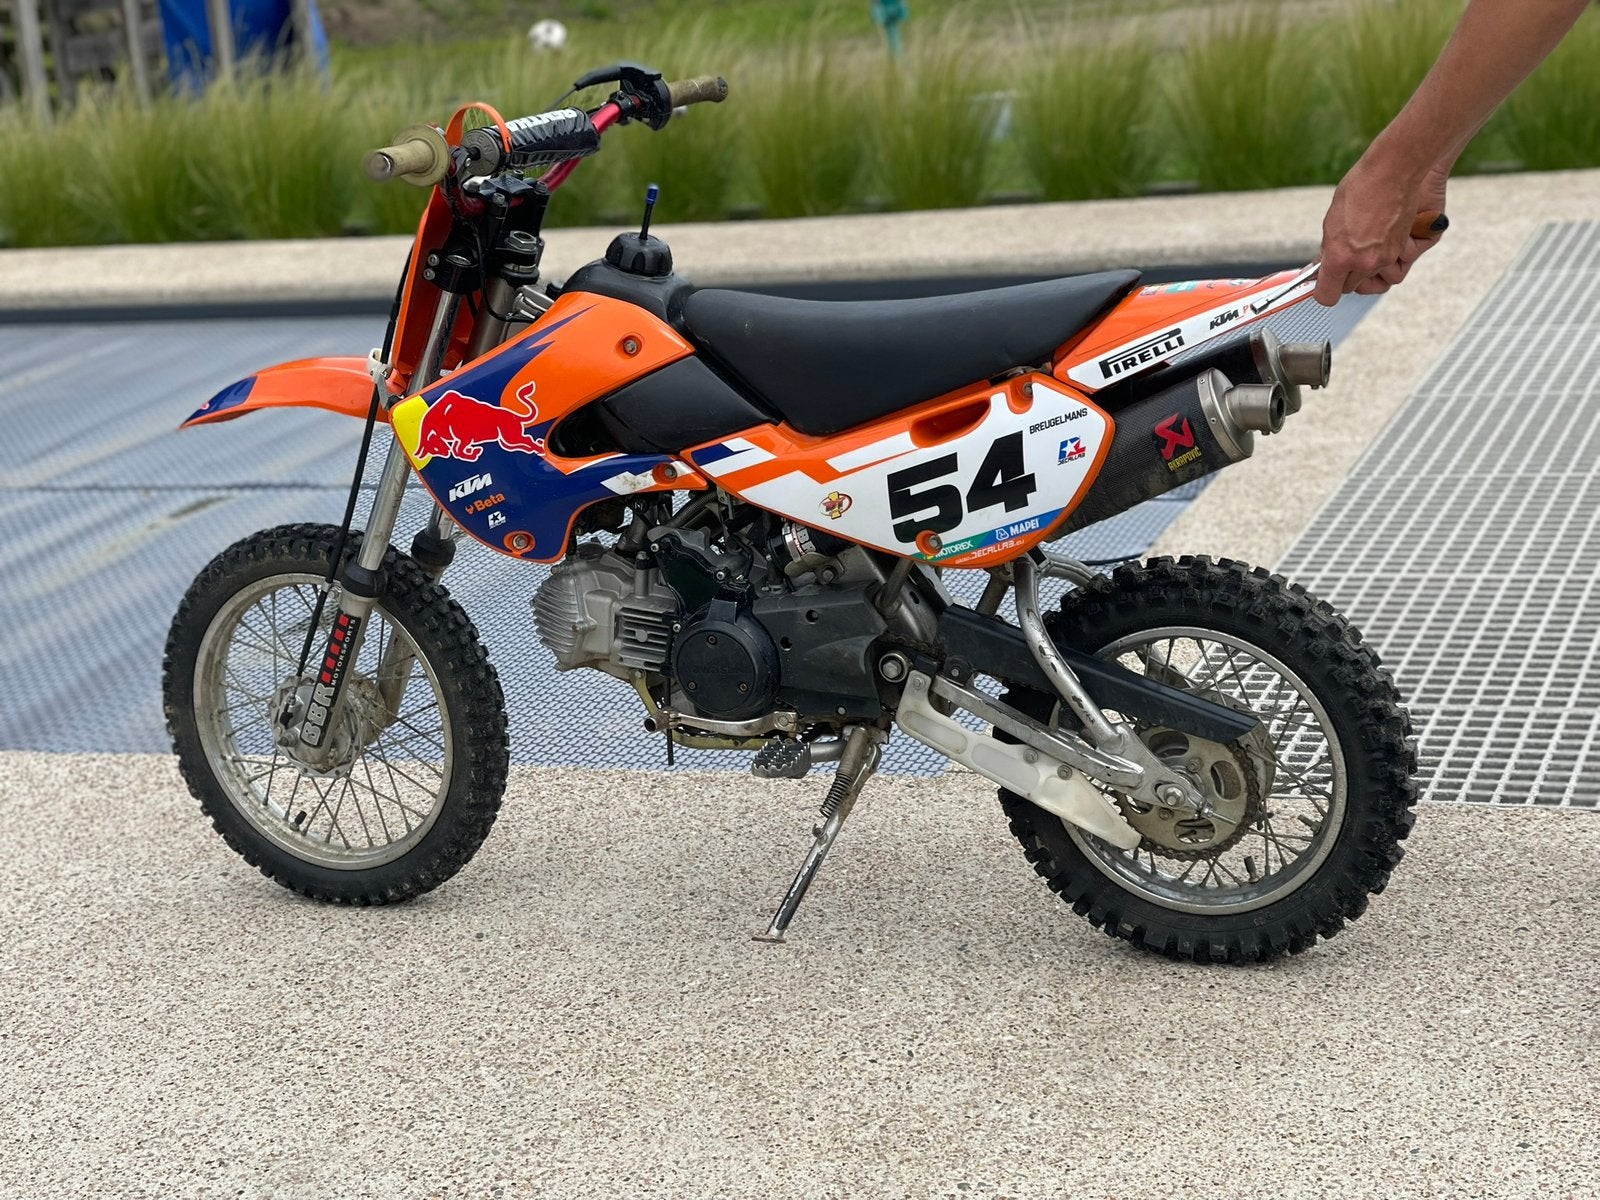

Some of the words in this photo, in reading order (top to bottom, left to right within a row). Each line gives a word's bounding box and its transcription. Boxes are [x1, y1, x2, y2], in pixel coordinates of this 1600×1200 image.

[493, 109, 577, 131] RENTHA
[1209, 310, 1239, 330] KTM
[1099, 328, 1185, 379] PIRELLI
[1029, 407, 1088, 434] BREUGELMANS
[449, 473, 493, 502] KTM
[887, 430, 1037, 544] 54
[474, 492, 506, 512] Beta
[1010, 518, 1040, 536] MAPEI
[301, 683, 335, 746] BBR
